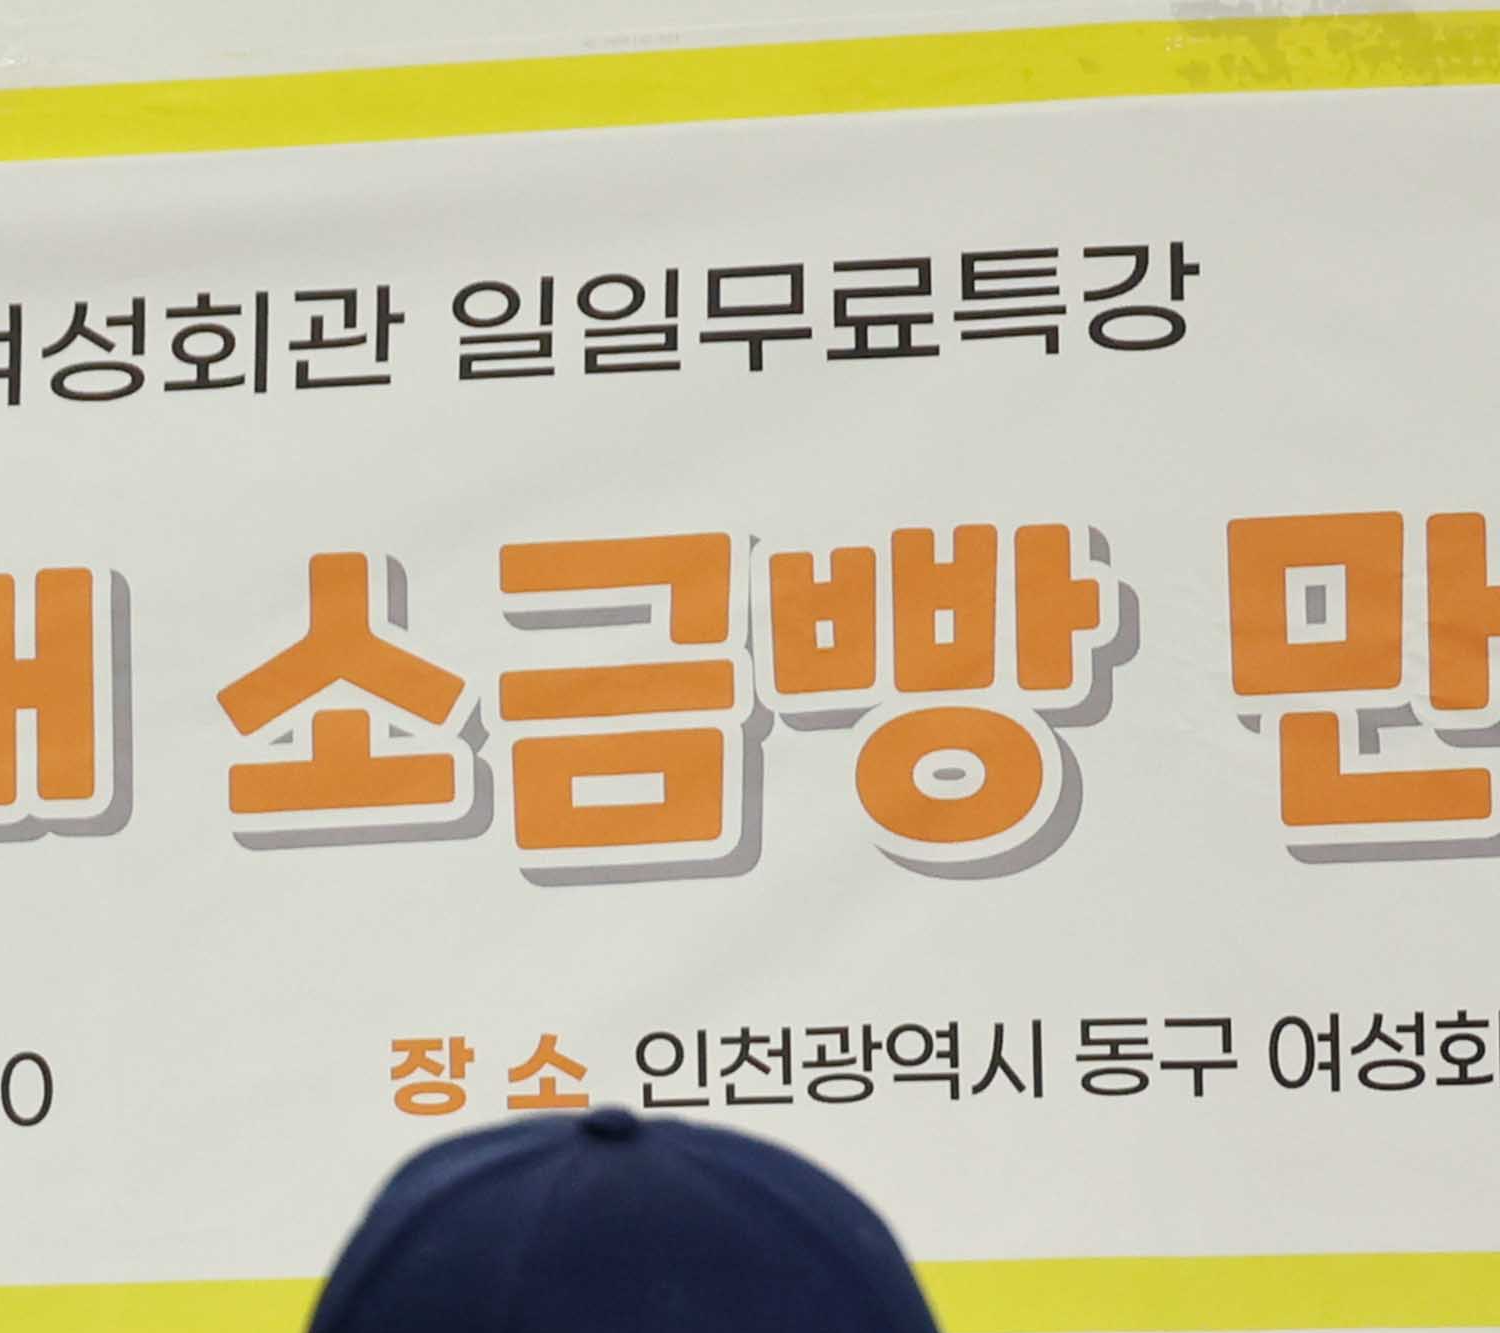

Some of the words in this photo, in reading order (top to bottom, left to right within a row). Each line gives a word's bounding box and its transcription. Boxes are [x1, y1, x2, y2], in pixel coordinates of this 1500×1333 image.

[451, 241, 1201, 381] 일일무료특강
[217, 523, 1110, 855] 소금빵
[635, 1019, 1044, 1109] 인천광역시
[1075, 1017, 1238, 1098] 동구
